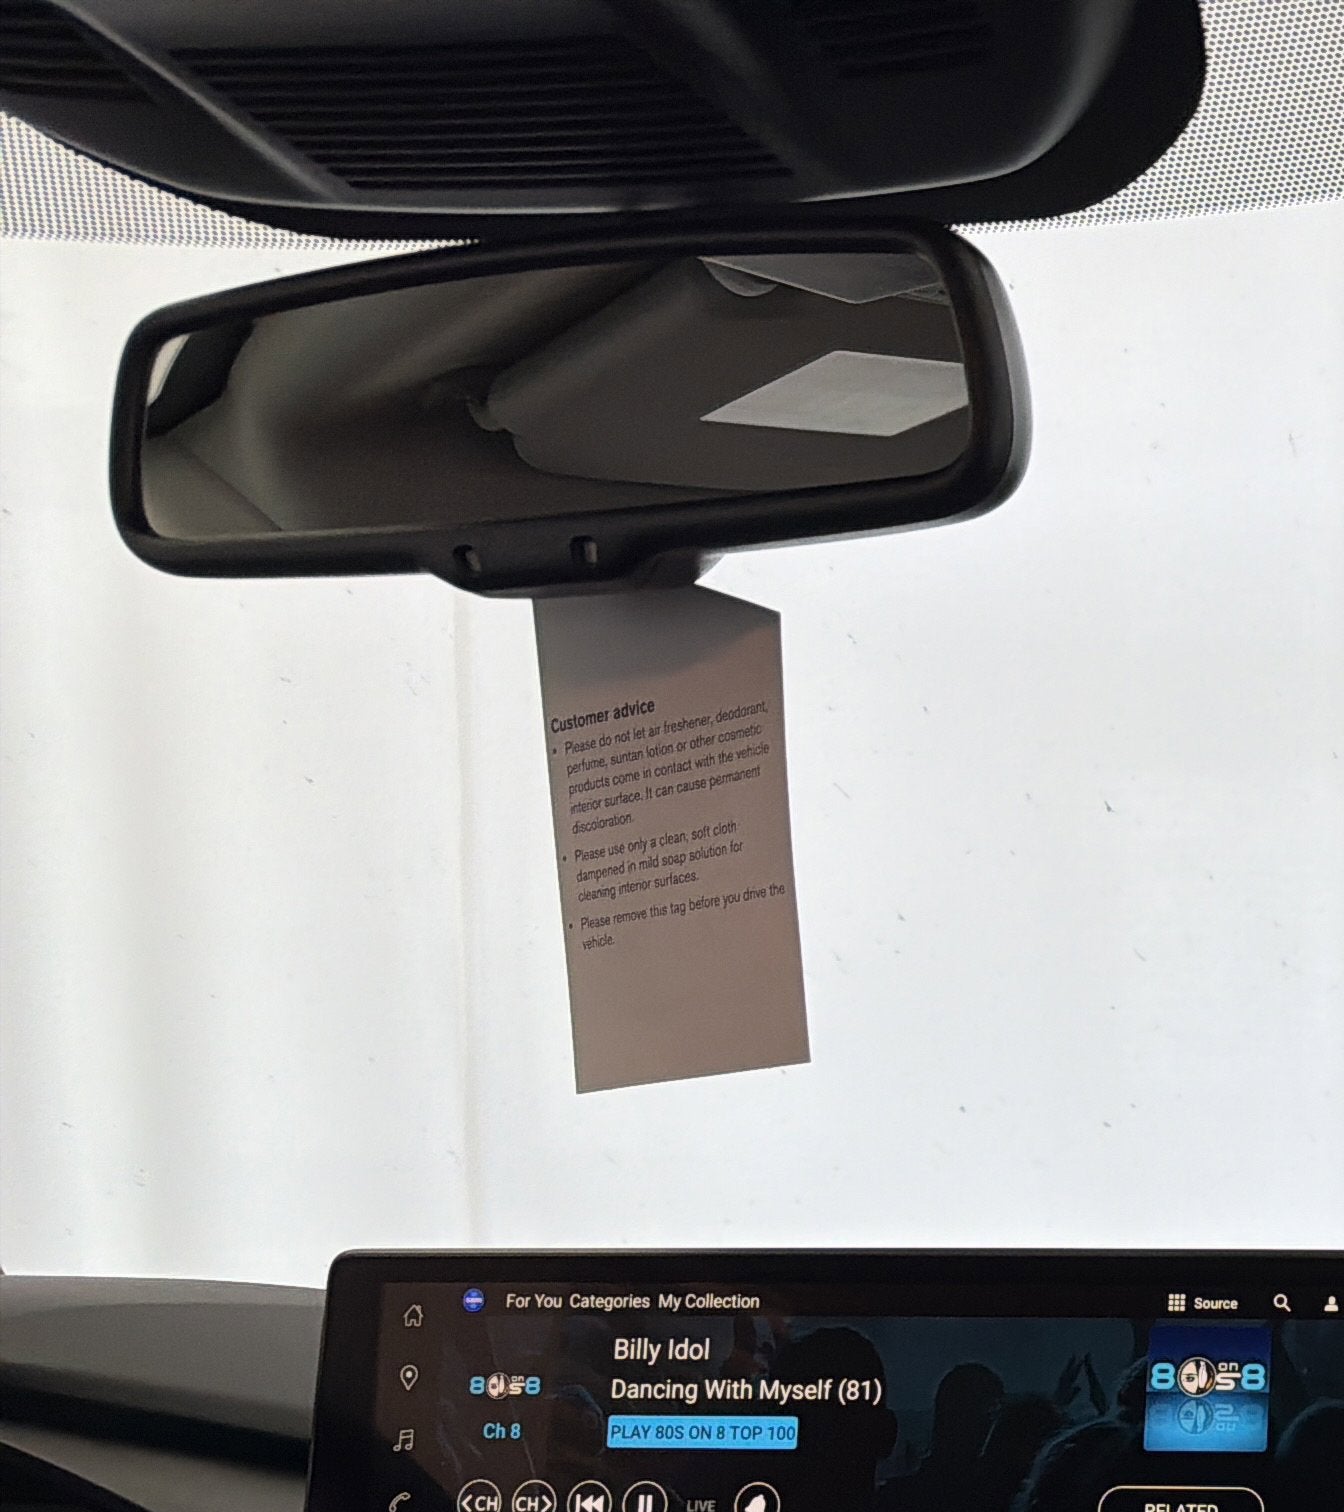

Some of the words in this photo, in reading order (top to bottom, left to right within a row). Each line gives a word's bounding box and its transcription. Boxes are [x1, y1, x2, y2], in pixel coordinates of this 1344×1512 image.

[550, 709, 611, 734] Customer
[612, 700, 656, 720] advice
[574, 848, 606, 863] Please
[607, 843, 626, 857] use
[627, 839, 648, 855] only
[691, 824, 712, 841] soft
[713, 820, 738, 838] cloth
[576, 861, 625, 885] dampened
[627, 860, 637, 873] in
[661, 853, 687, 873] soap
[689, 843, 728, 862] solution
[729, 841, 743, 855] for
[506, 1293, 531, 1309] For
[534, 1293, 562, 1309] You
[569, 1293, 650, 1312] Categories
[658, 1293, 681, 1312] My
[684, 1293, 760, 1309] Collection
[1194, 1296, 1239, 1310] Source
[614, 1338, 661, 1364] Billy
[668, 1338, 710, 1360] Idol
[611, 1380, 698, 1406] Dancing
[704, 1380, 754, 1401] With
[758, 1379, 832, 1406] Myself
[838, 1379, 882, 1405] (81)
[483, 1422, 507, 1440] Ch
[510, 1422, 521, 1440] 8
[611, 1425, 650, 1441] PLAY
[655, 1425, 686, 1441] 80S
[691, 1426, 713, 1441] ON
[716, 1426, 726, 1441] 8
[729, 1426, 761, 1441] TOP
[766, 1425, 796, 1442] 100
